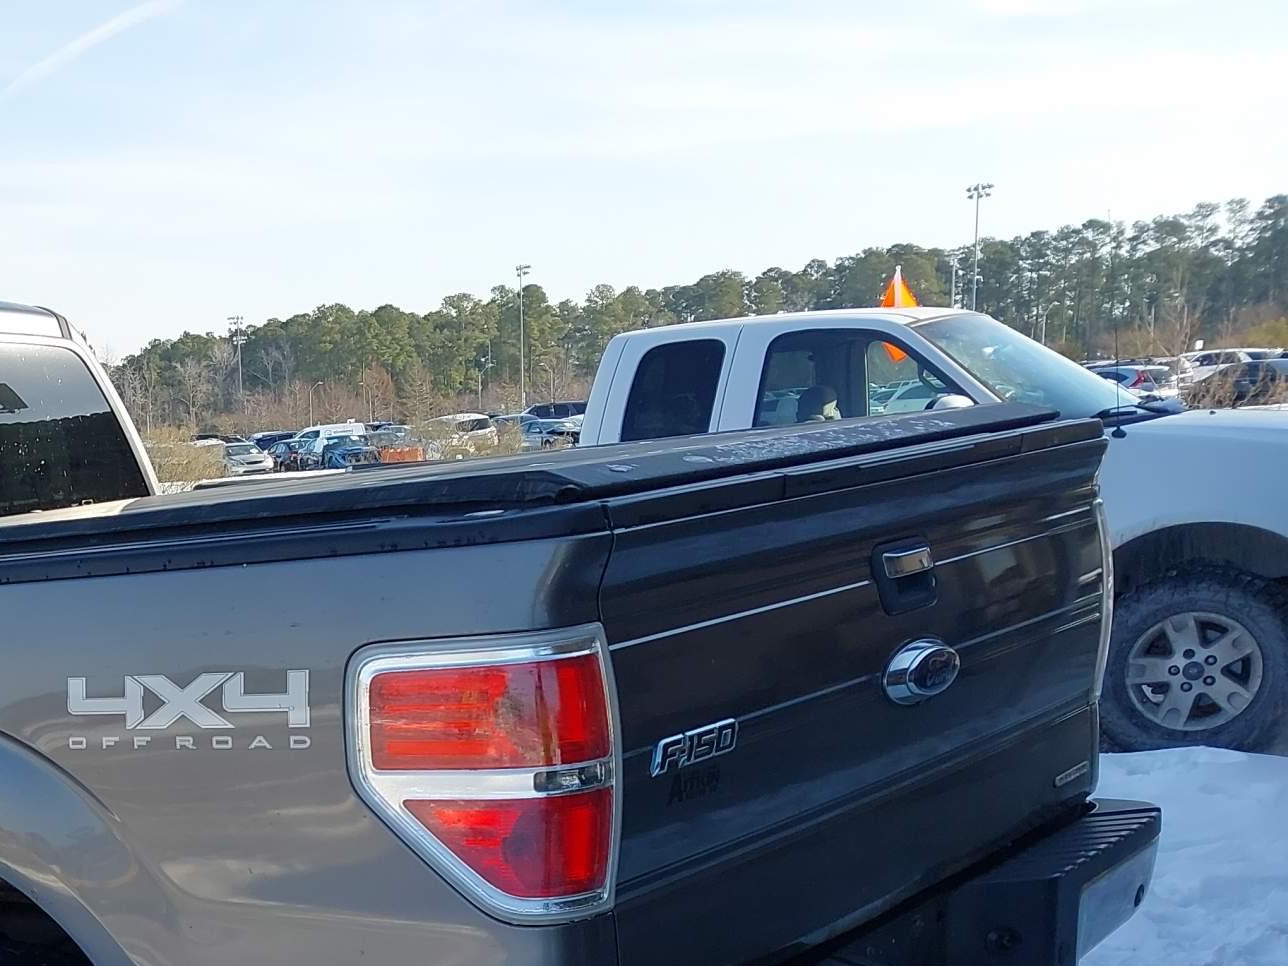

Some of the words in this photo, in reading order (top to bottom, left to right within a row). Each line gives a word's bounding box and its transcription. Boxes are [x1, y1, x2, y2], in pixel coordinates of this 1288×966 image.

[67, 669, 310, 730] 4X4
[68, 735, 152, 750] OFF
[175, 735, 312, 750] ROAD
